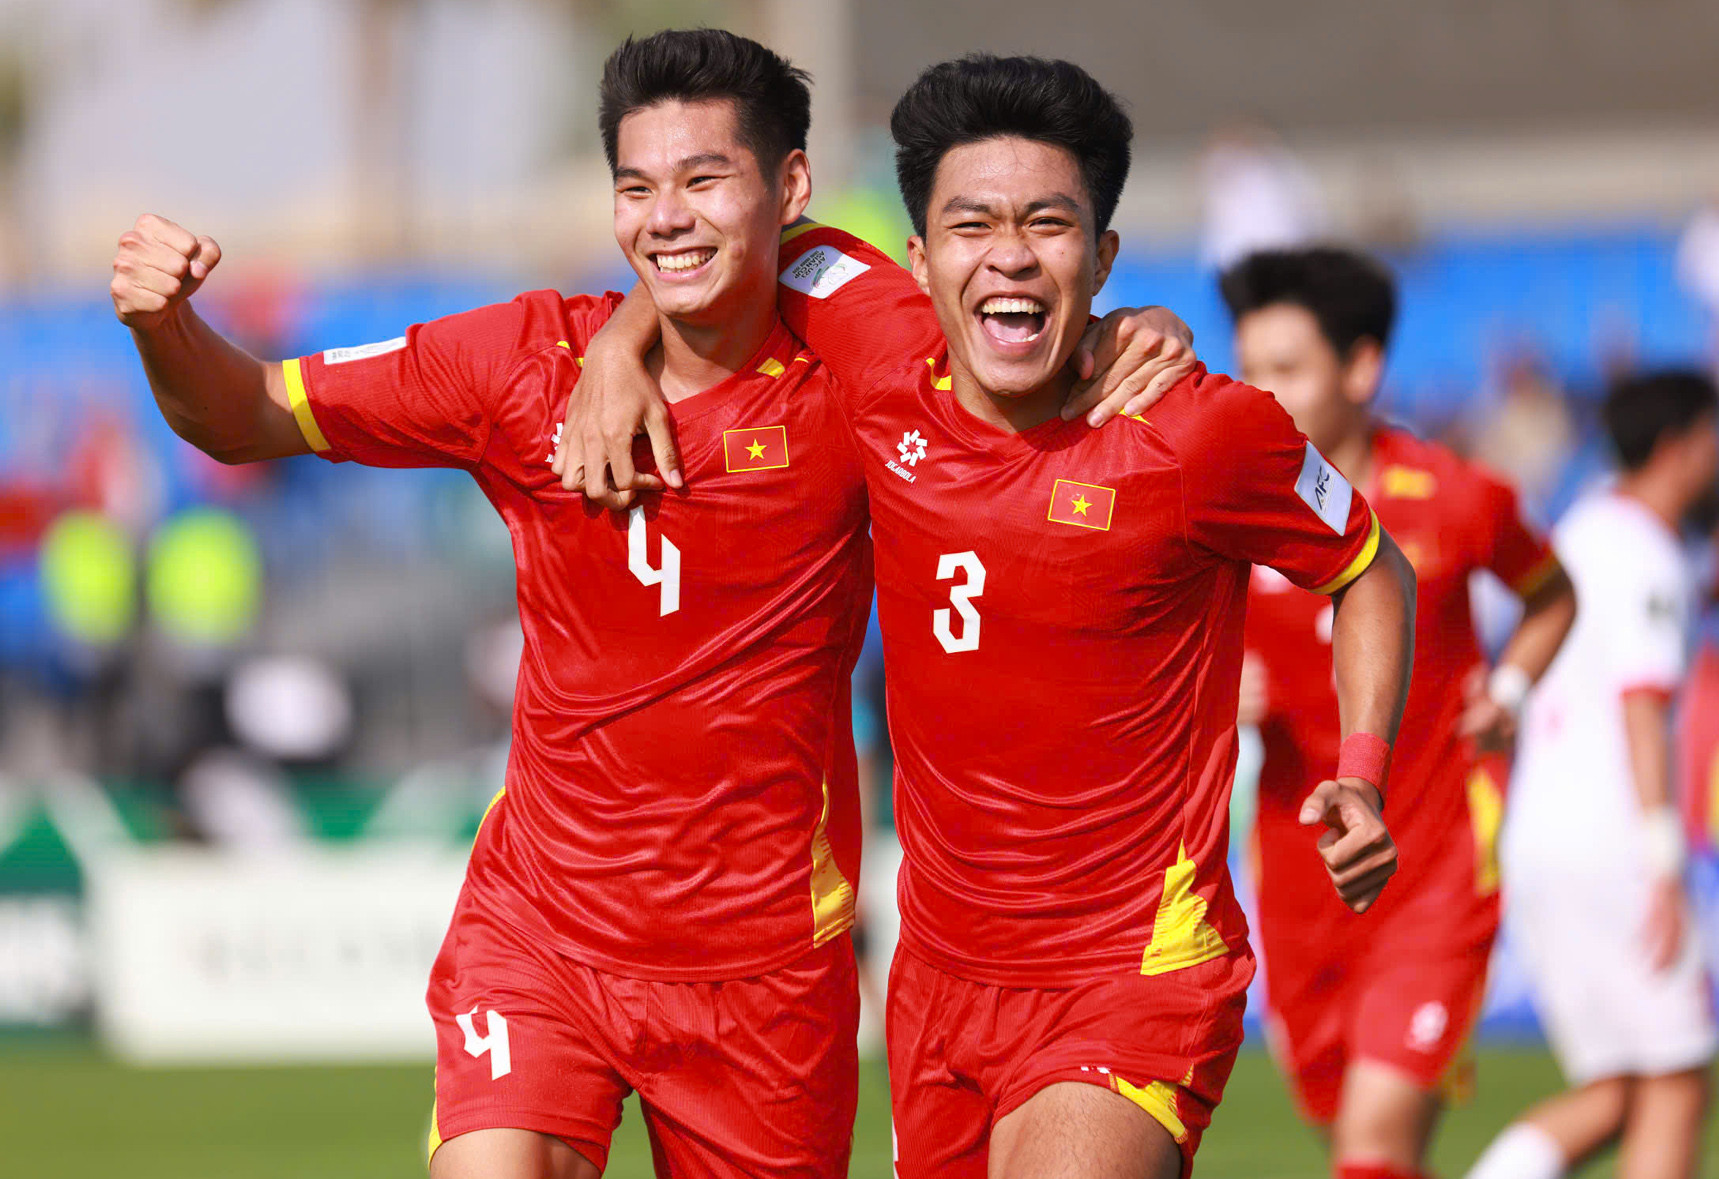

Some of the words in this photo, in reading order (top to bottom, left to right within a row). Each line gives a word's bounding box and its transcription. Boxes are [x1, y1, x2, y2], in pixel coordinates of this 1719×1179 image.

[1314, 465, 1330, 511] AFC
[627, 505, 681, 617] 4
[933, 550, 986, 654] 3
[455, 1004, 511, 1081] 4
